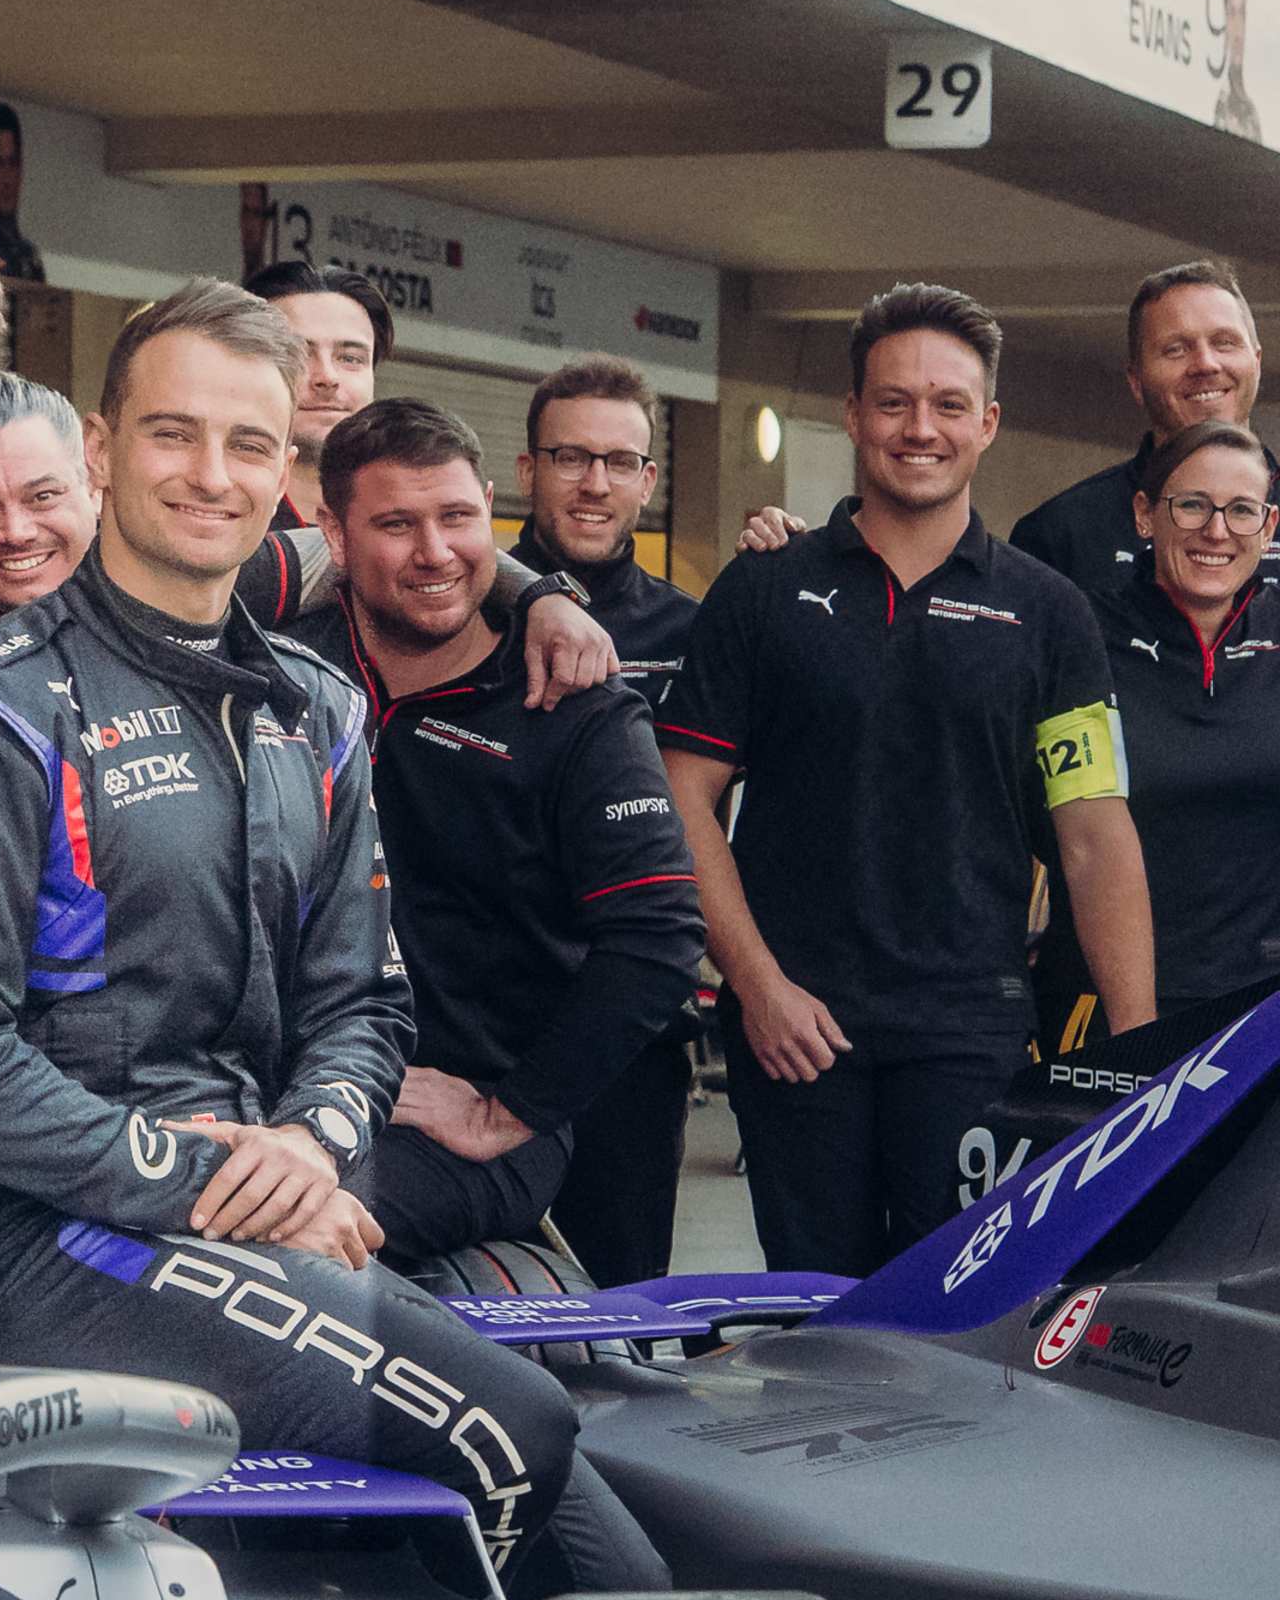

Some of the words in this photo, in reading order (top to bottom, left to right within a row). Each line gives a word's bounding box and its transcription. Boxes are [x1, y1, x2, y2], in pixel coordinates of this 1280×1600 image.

[895, 62, 982, 117] 29
[930, 596, 1016, 619] PORSCHE
[78, 709, 152, 757] Mobil
[422, 716, 509, 754] PORSCHE
[127, 751, 197, 786] TDK
[1023, 1009, 1258, 1229] TDK
[449, 1299, 592, 1311] RACING
[1047, 1299, 1089, 1349] E
